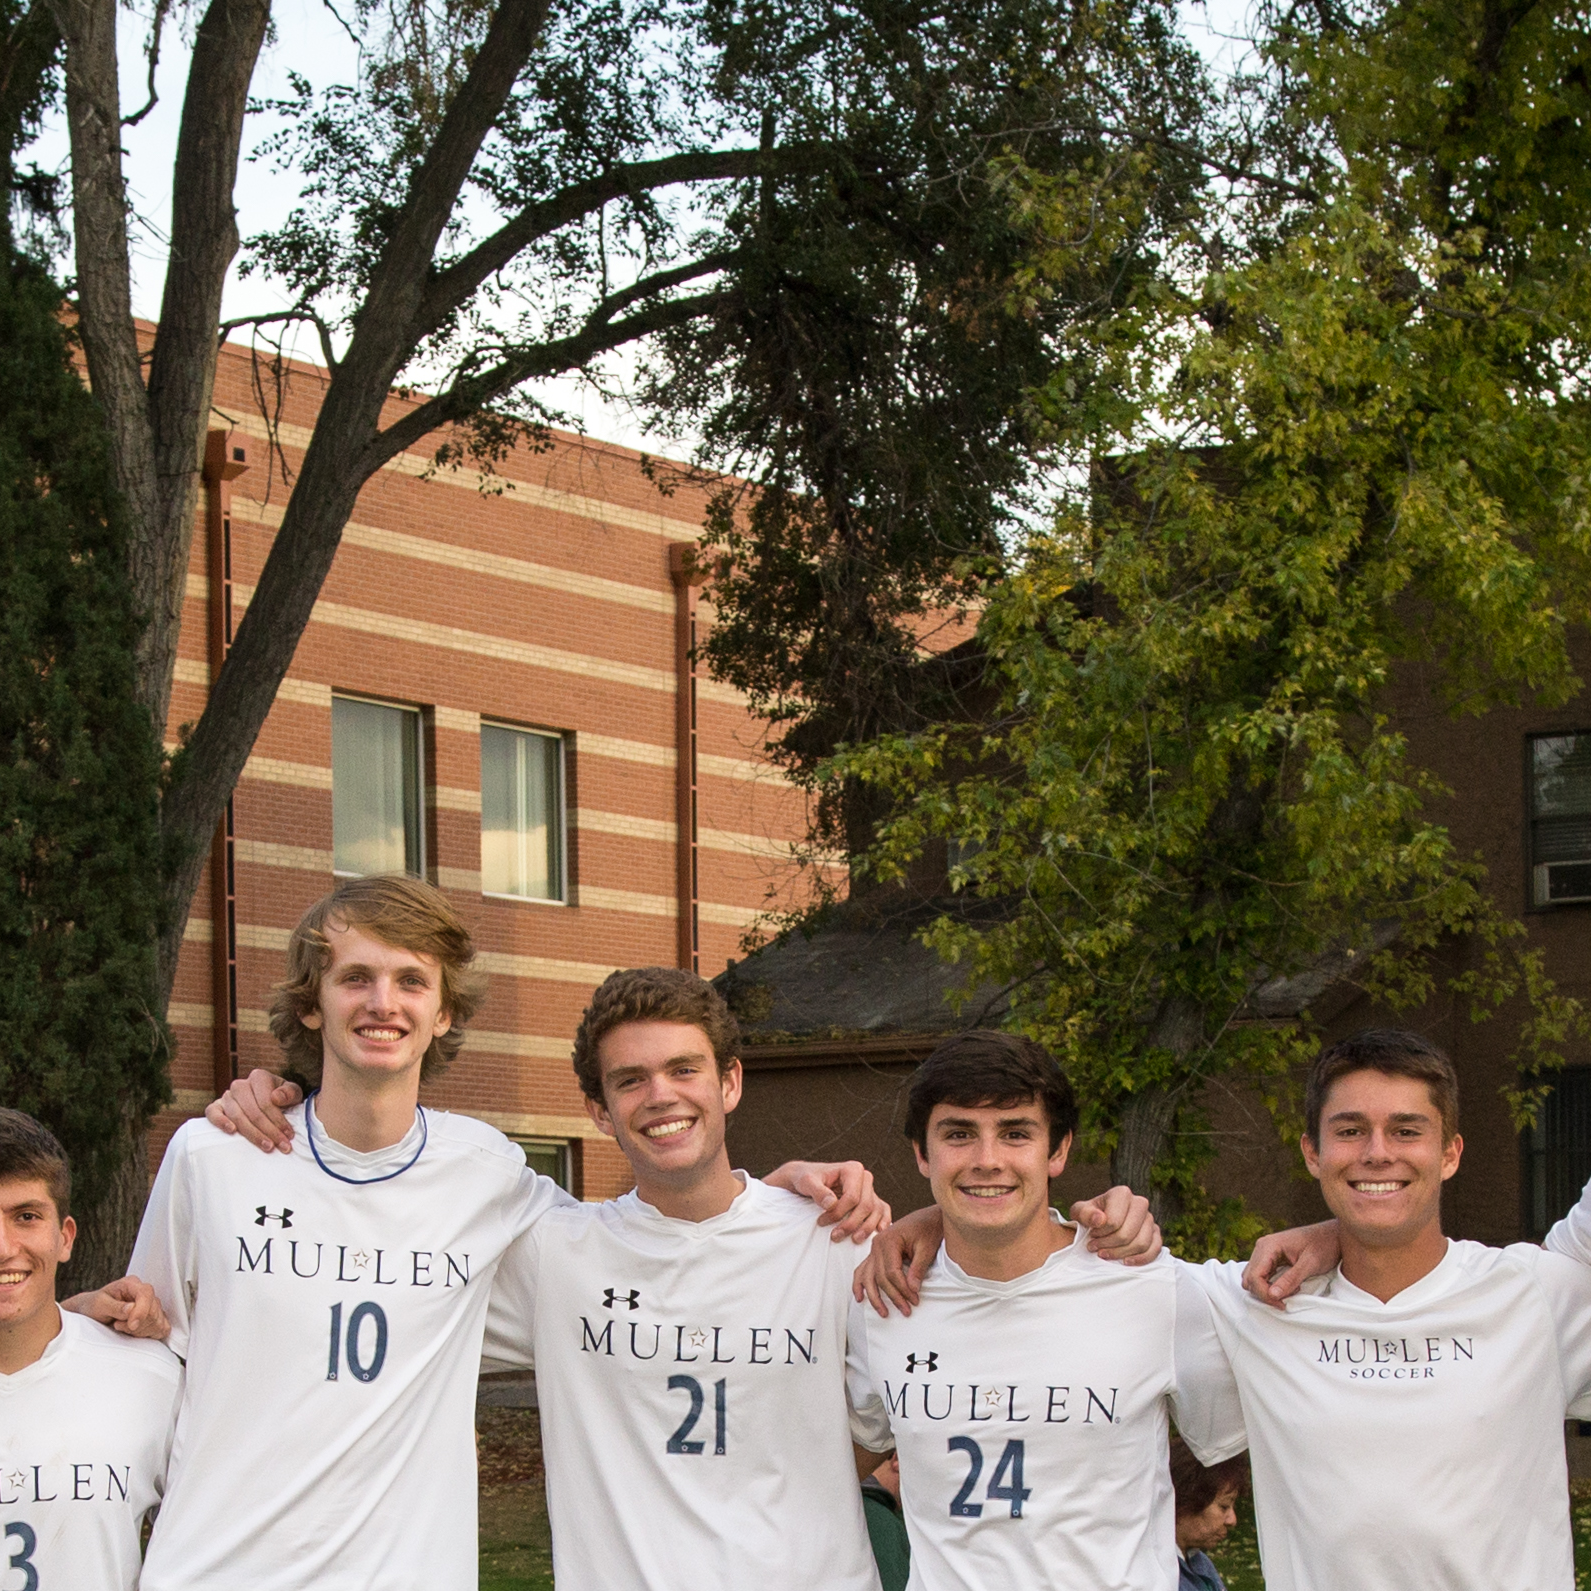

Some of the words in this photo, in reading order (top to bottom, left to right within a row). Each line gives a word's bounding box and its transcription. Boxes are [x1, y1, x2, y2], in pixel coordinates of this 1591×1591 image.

[236, 1237, 469, 1287] MULLEN
[327, 1302, 387, 1382] 10
[580, 1317, 815, 1364] MULLEN
[1318, 1337, 1473, 1364] MULLEN
[1350, 1368, 1435, 1379] SOCCER
[667, 1375, 725, 1455] 21
[881, 1381, 1118, 1425] MULLEN
[948, 1436, 1031, 1519] 24
